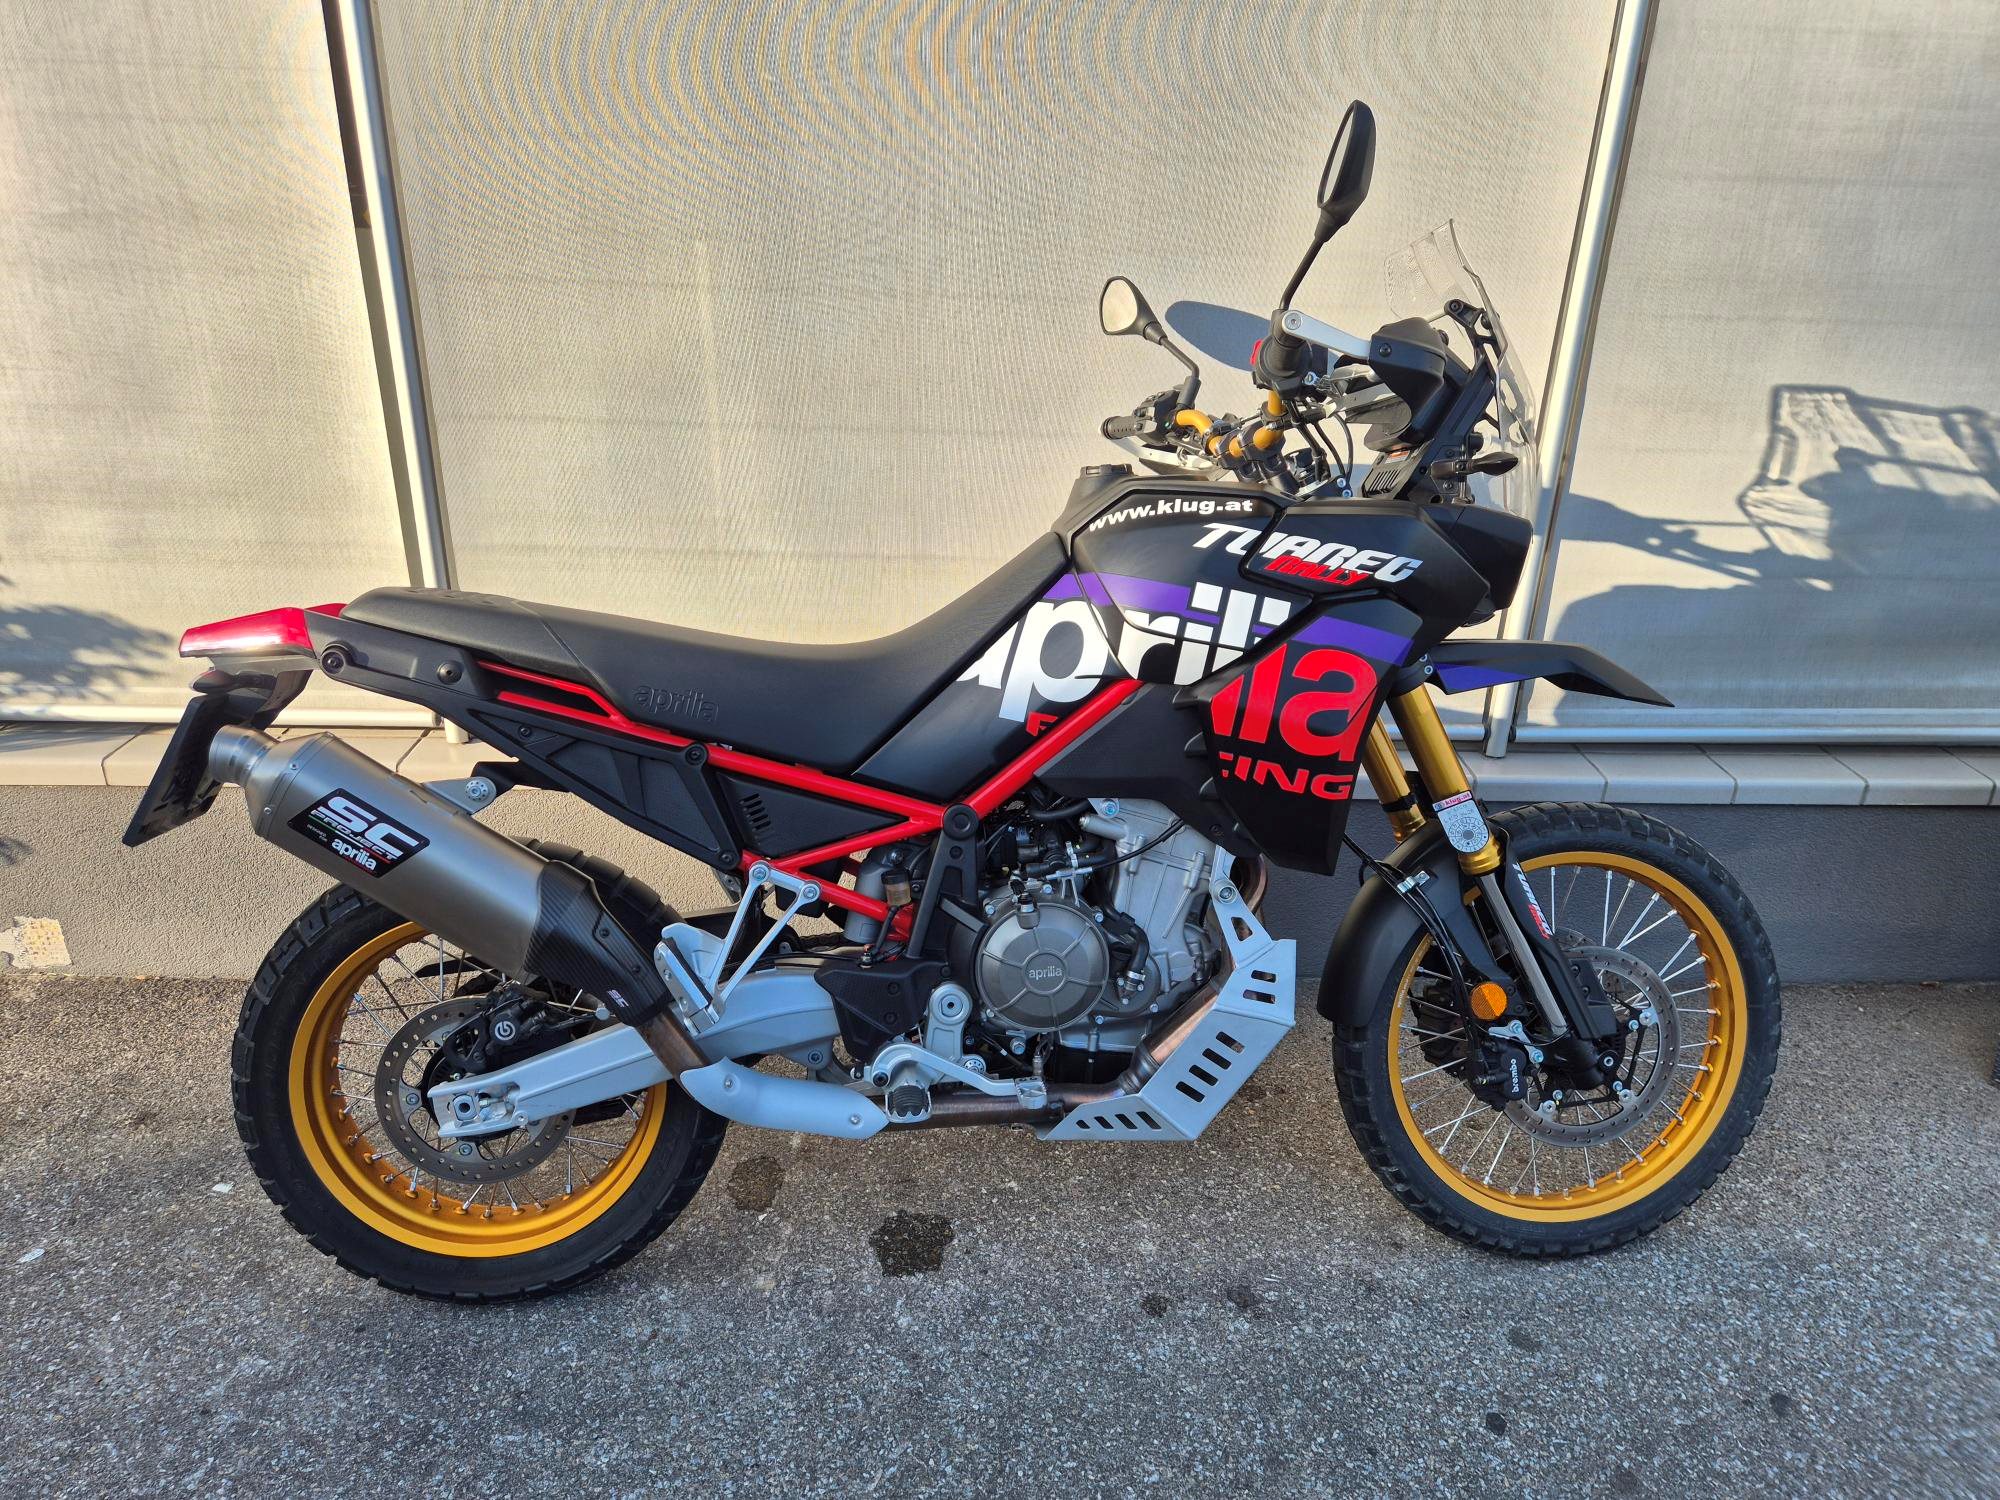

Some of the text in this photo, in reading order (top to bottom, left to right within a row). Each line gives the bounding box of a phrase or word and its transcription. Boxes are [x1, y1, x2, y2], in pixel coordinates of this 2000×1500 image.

[1089, 498, 1253, 532] www.klug.at
[1263, 555, 1370, 586] RALLY
[633, 686, 720, 724] aprilia
[317, 796, 420, 858] SC
[331, 838, 377, 871] aprilia
[1029, 965, 1062, 980] aprilia
[1510, 1058, 1519, 1093] brembo
